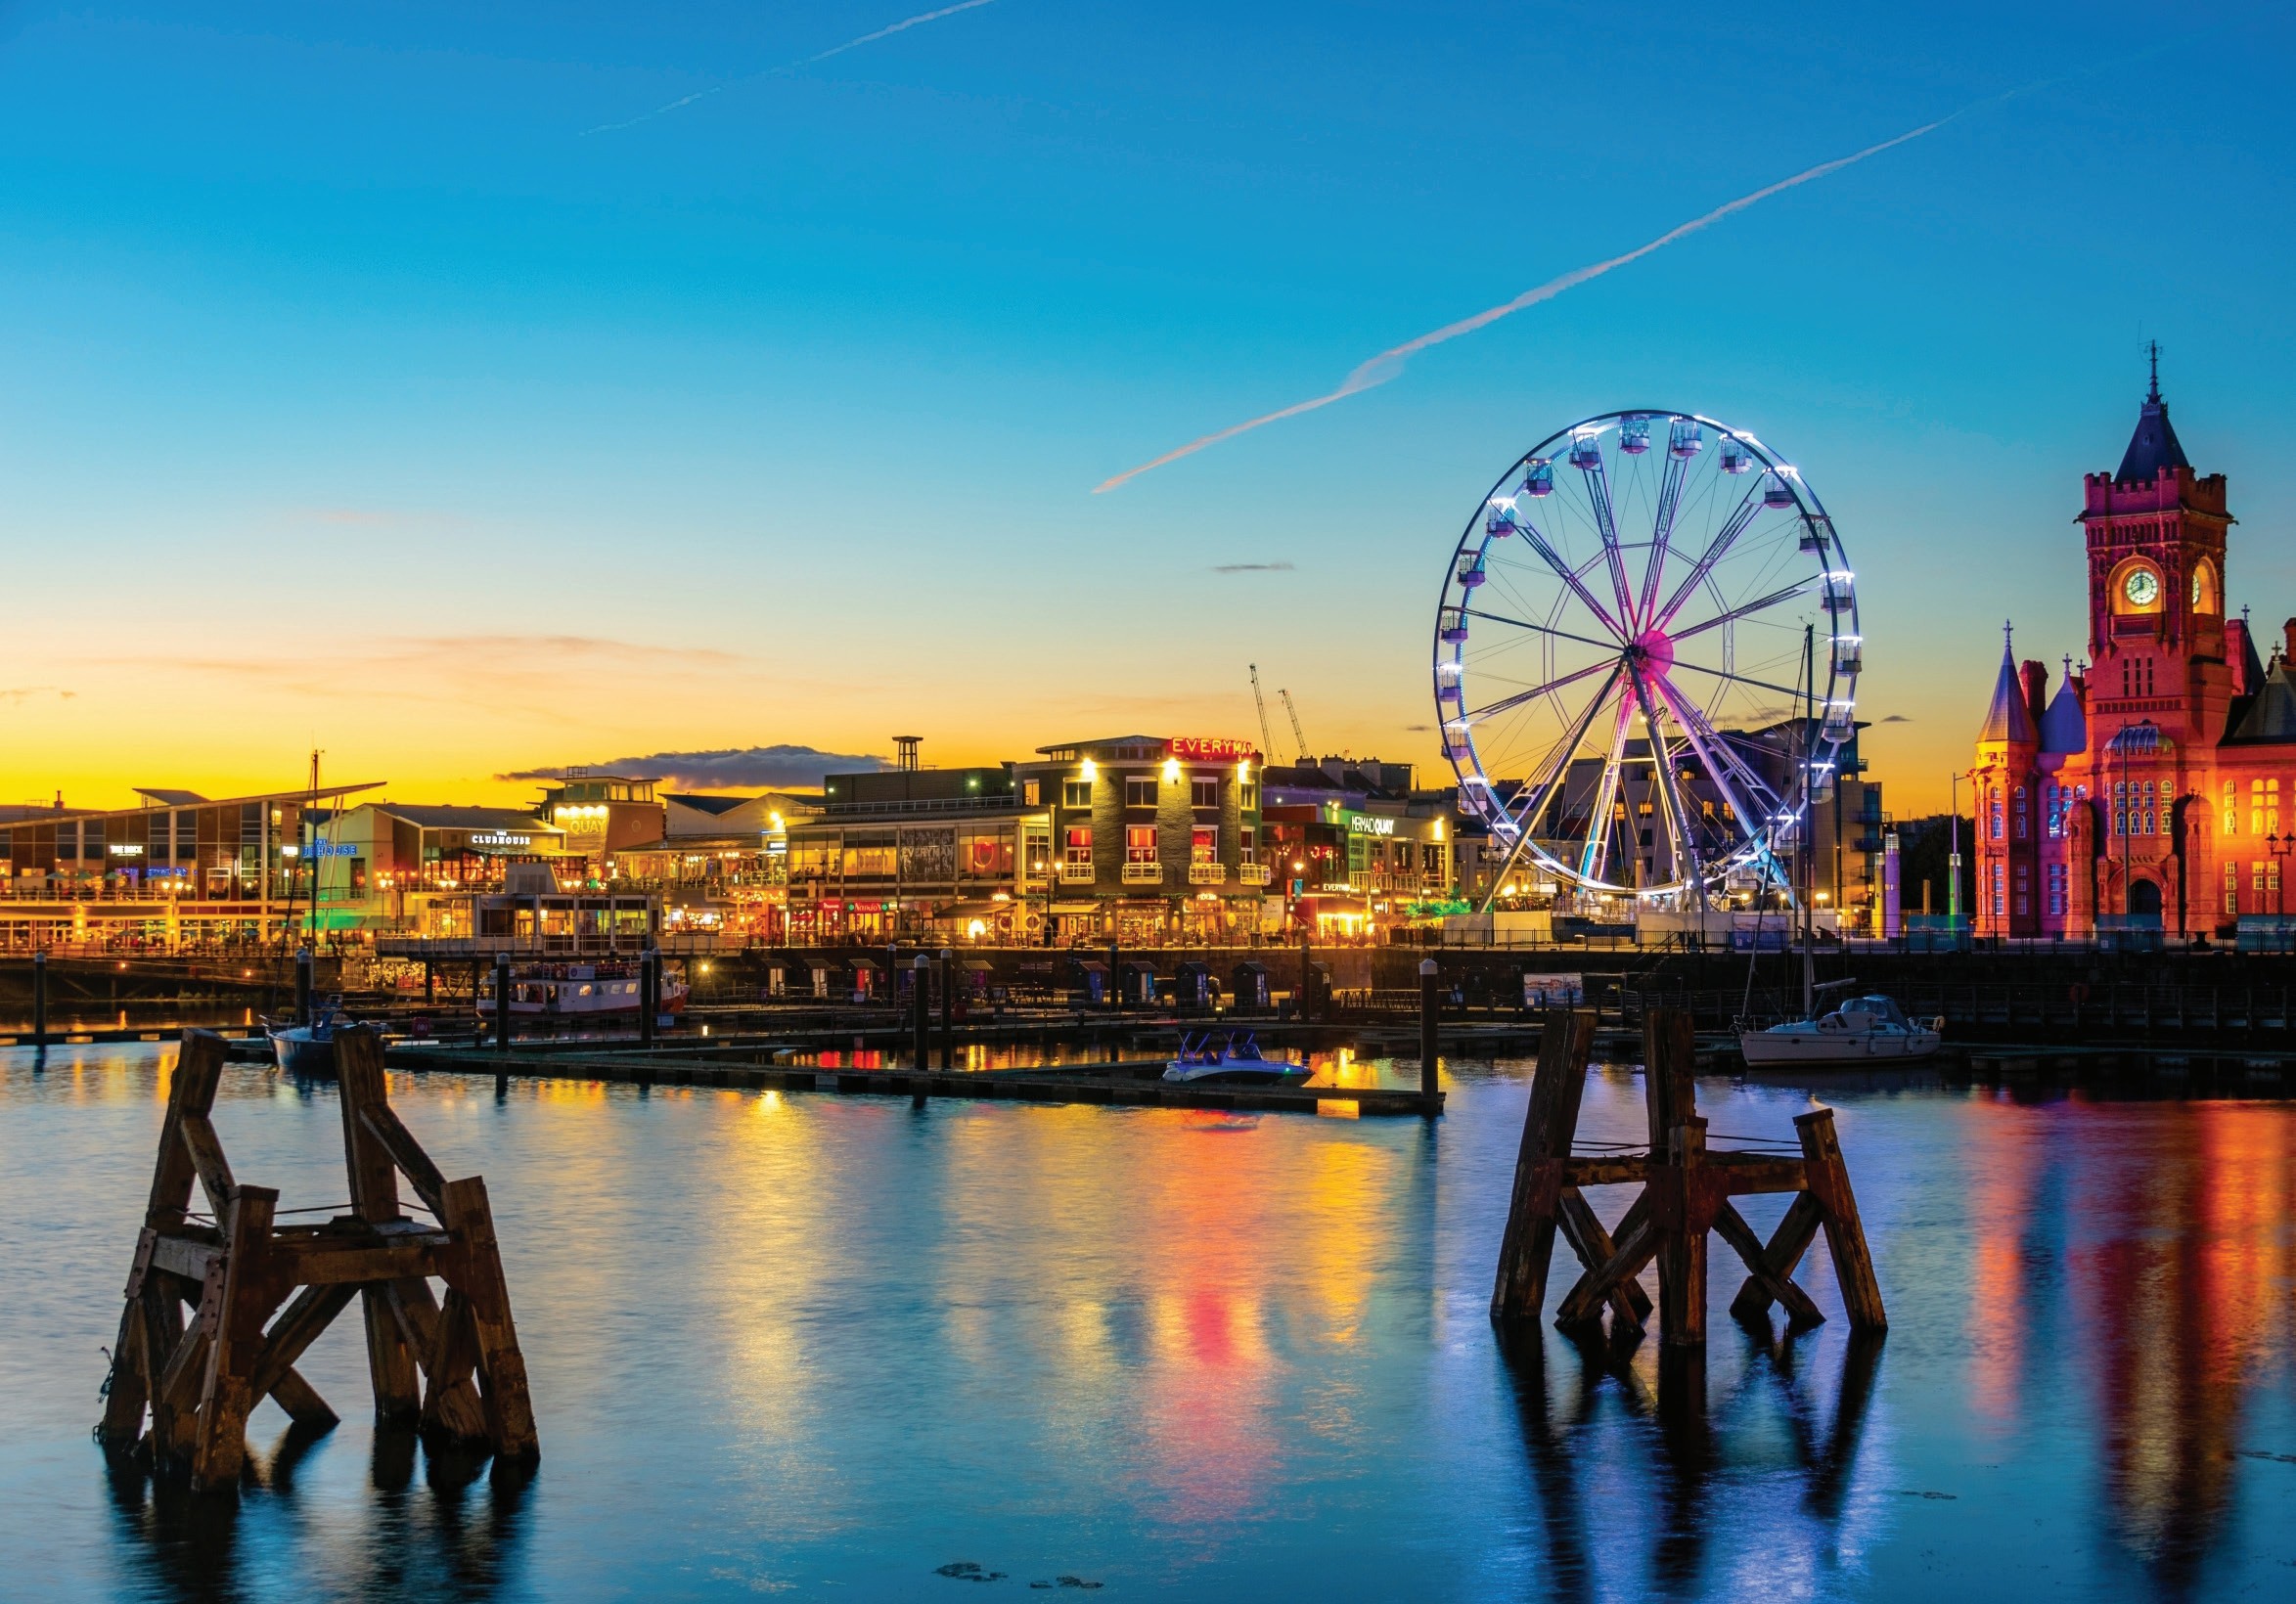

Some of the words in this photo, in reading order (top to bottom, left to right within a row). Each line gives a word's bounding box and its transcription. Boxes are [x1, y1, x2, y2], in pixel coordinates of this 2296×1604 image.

[570, 820, 608, 835] QUAY
[1374, 818, 1394, 836] QUAY
[472, 834, 531, 845] CLUBHOUSE
